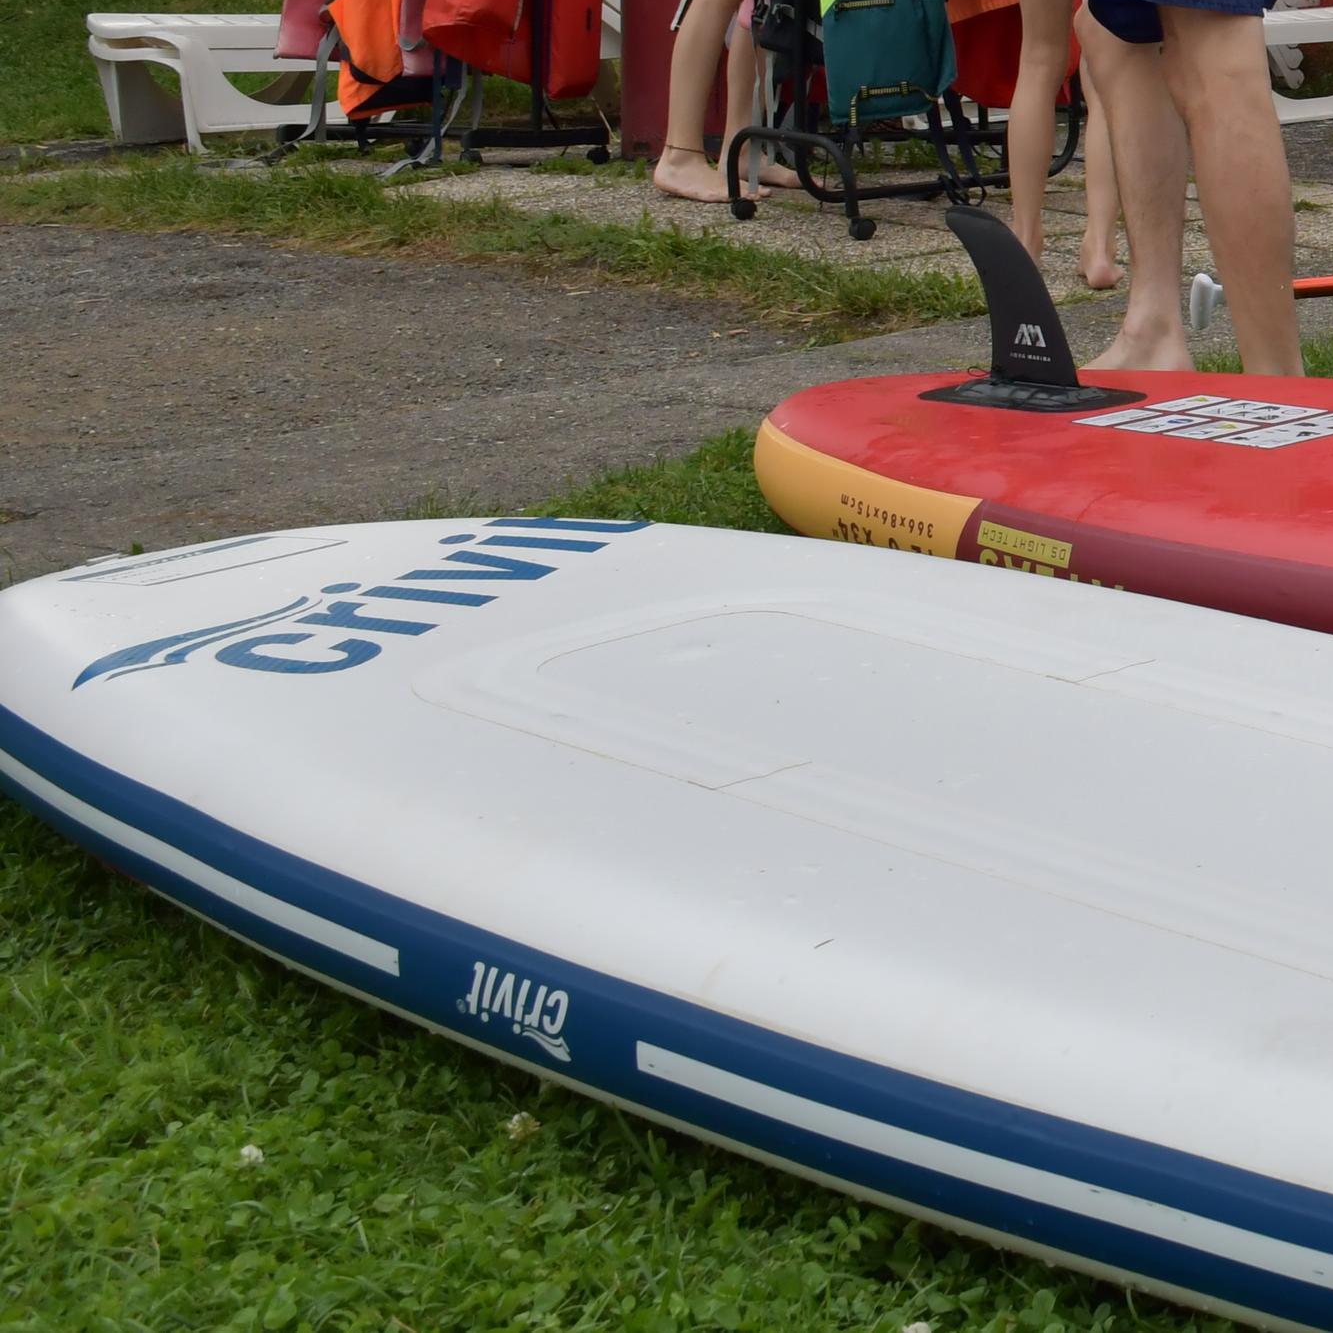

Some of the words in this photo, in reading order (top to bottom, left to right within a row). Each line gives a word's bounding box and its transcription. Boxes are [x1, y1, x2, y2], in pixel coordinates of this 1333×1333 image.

[839, 492, 935, 539] 366x86x15cm
[981, 528, 1009, 547] TECH
[1013, 536, 1047, 558] LIGHT
[1051, 546, 1068, 562] DS
[466, 961, 569, 1034] crivit
